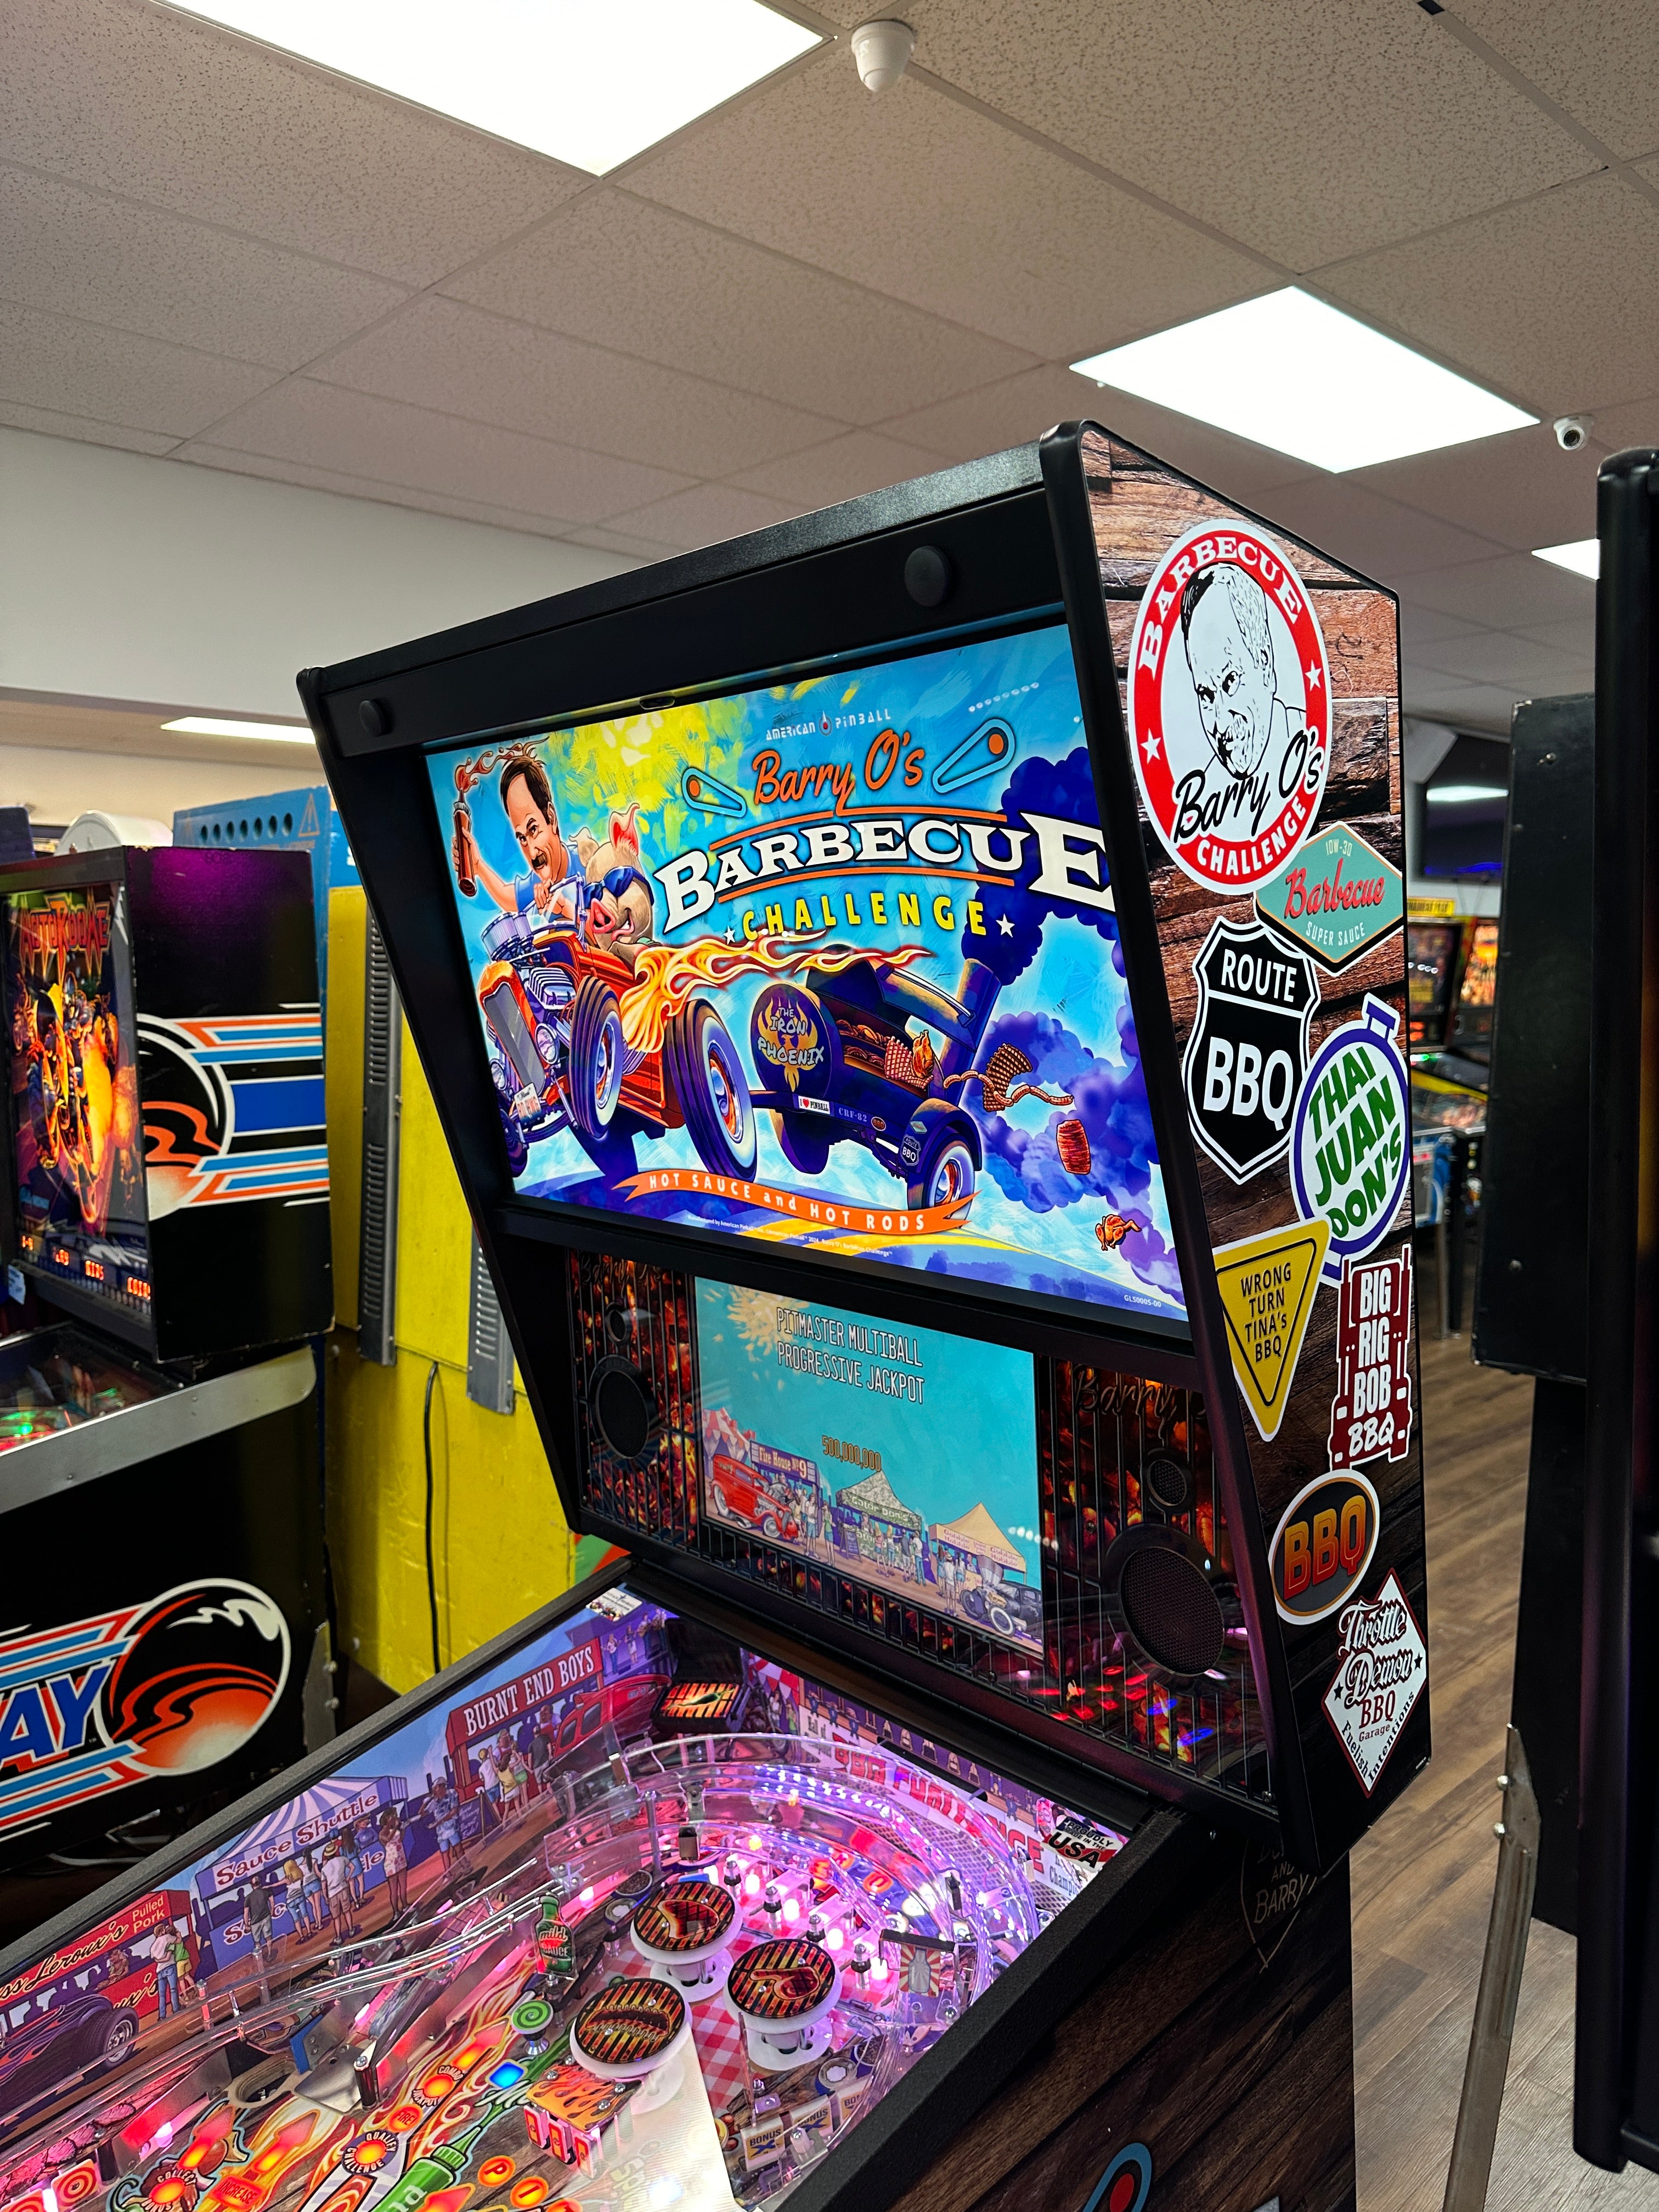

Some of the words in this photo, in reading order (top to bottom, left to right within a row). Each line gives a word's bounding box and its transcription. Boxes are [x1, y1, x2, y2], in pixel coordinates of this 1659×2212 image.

[1138, 536, 1303, 681] BARBECUE
[753, 749, 856, 816] Barry
[865, 729, 926, 791] O's
[1173, 769, 1270, 843] Barry
[1278, 730, 1323, 790] O's
[1197, 798, 1306, 877] CHALLENGE
[653, 812, 1116, 935] BARBECUE
[1284, 857, 1386, 919] Barbecue
[742, 891, 987, 942] CHALLENGE
[1306, 921, 1334, 946] SUPER
[1338, 922, 1365, 946] SAUCE
[1222, 949, 1297, 1003] ROUTE
[769, 1015, 806, 1036] IRON
[778, 1007, 794, 1018] THE
[757, 1036, 825, 1065] PHOENIX
[810, 1101, 829, 1112] PINBALL
[1203, 1036, 1294, 1131] BBQ
[1309, 1046, 1376, 1139] THAI
[839, 1107, 867, 1122] CRF-82
[902, 1146, 916, 1163] BBQ
[1315, 1075, 1396, 1206] JUAN
[650, 1173, 680, 1189] HOT
[692, 1174, 751, 1199] SAUCE
[764, 1189, 797, 1211] and
[810, 1203, 850, 1226] HOT
[866, 1214, 924, 1231] RODS
[1325, 1121, 1402, 1238] DON'S
[720, 1221, 740, 1229] American
[1241, 1262, 1291, 1297] WRONG
[1249, 1288, 1284, 1316] TURN
[1361, 1267, 1392, 1319] BIG
[776, 1307, 845, 1347] PITMASTER
[848, 1323, 923, 1367] MULTIBALL
[1255, 1341, 1282, 1363] BBQ
[1358, 1316, 1390, 1369] RIG
[777, 1340, 863, 1387] PROGRESSIVE
[866, 1364, 925, 1404] JACKPOT
[1353, 1363, 1392, 1419] BOB
[1074, 1364, 1177, 1440] Barry
[821, 1435, 882, 1472] 500,000,000
[1348, 1410, 1394, 1458] BBQ
[758, 1446, 771, 1465] Fire
[772, 1450, 791, 1471] House
[1284, 1494, 1367, 1600] BBQ
[1338, 1598, 1407, 1659] Throttle
[464, 1684, 519, 1736] BURNT
[523, 1667, 555, 1706] END
[558, 1645, 595, 1688] BOYS
[1345, 1649, 1413, 1706] Demon
[1358, 1690, 1396, 1730] BBQ
[1358, 1724, 1391, 1742] Garage
[1341, 1720, 1369, 1779] Fuelish
[1368, 1692, 1414, 1784] Intentions
[216, 1839, 292, 1886] Sauce
[296, 1794, 377, 1844] Shuttle
[1048, 1831, 1101, 1869] USA
[1064, 1827, 1082, 1839] MADE
[1092, 1842, 1107, 1852] THE
[1066, 1820, 1114, 1848] PROUDLY
[132, 1895, 164, 1922] Pulled
[133, 1909, 165, 1934] Pork
[1254, 1874, 1309, 1923] BARRY
[24, 1921, 129, 1991] Leroux's
[539, 1925, 568, 1942] mild
[438, 2065, 464, 2081] COMBO
[397, 2109, 417, 2125] FIRE!
[411, 2089, 439, 2107] JACKPOT
[366, 2131, 397, 2152] QUALIFY
[749, 2128, 781, 2146] BONUS
[157, 2168, 196, 2186] COLLECT
[219, 2181, 258, 2204] INCREASE
